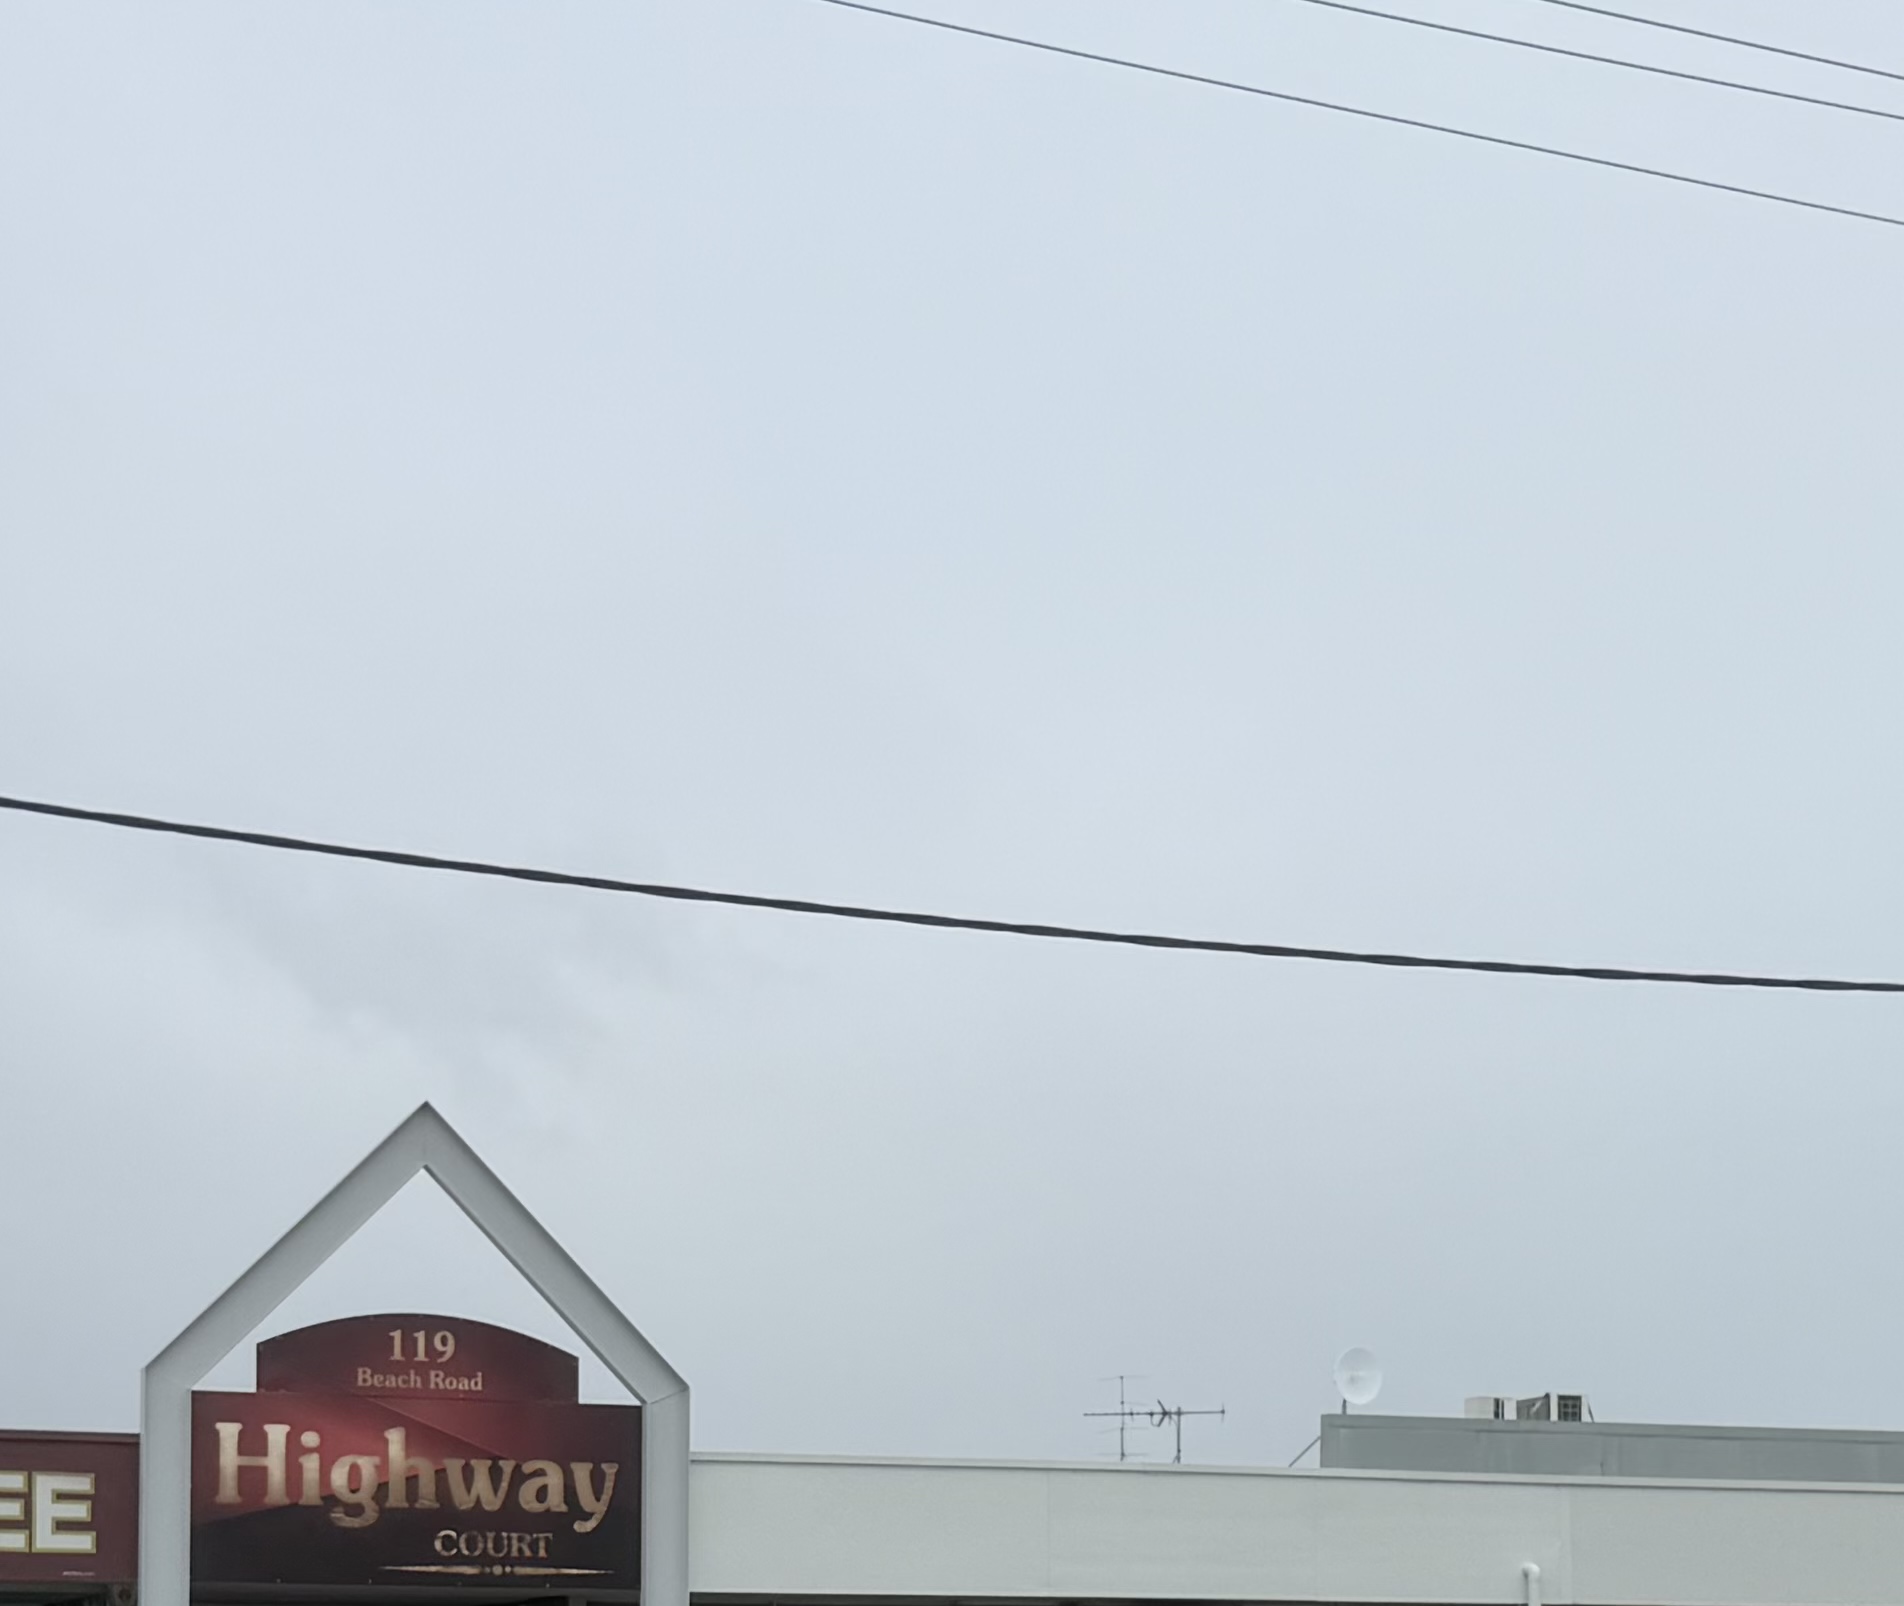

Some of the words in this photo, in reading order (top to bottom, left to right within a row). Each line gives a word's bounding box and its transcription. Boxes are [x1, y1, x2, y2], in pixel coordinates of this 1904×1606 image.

[388, 1329, 456, 1363] 119
[356, 1367, 422, 1389] Beach
[429, 1371, 483, 1391] Road
[214, 1421, 619, 1533] Highway
[434, 1528, 554, 1558] COURT
